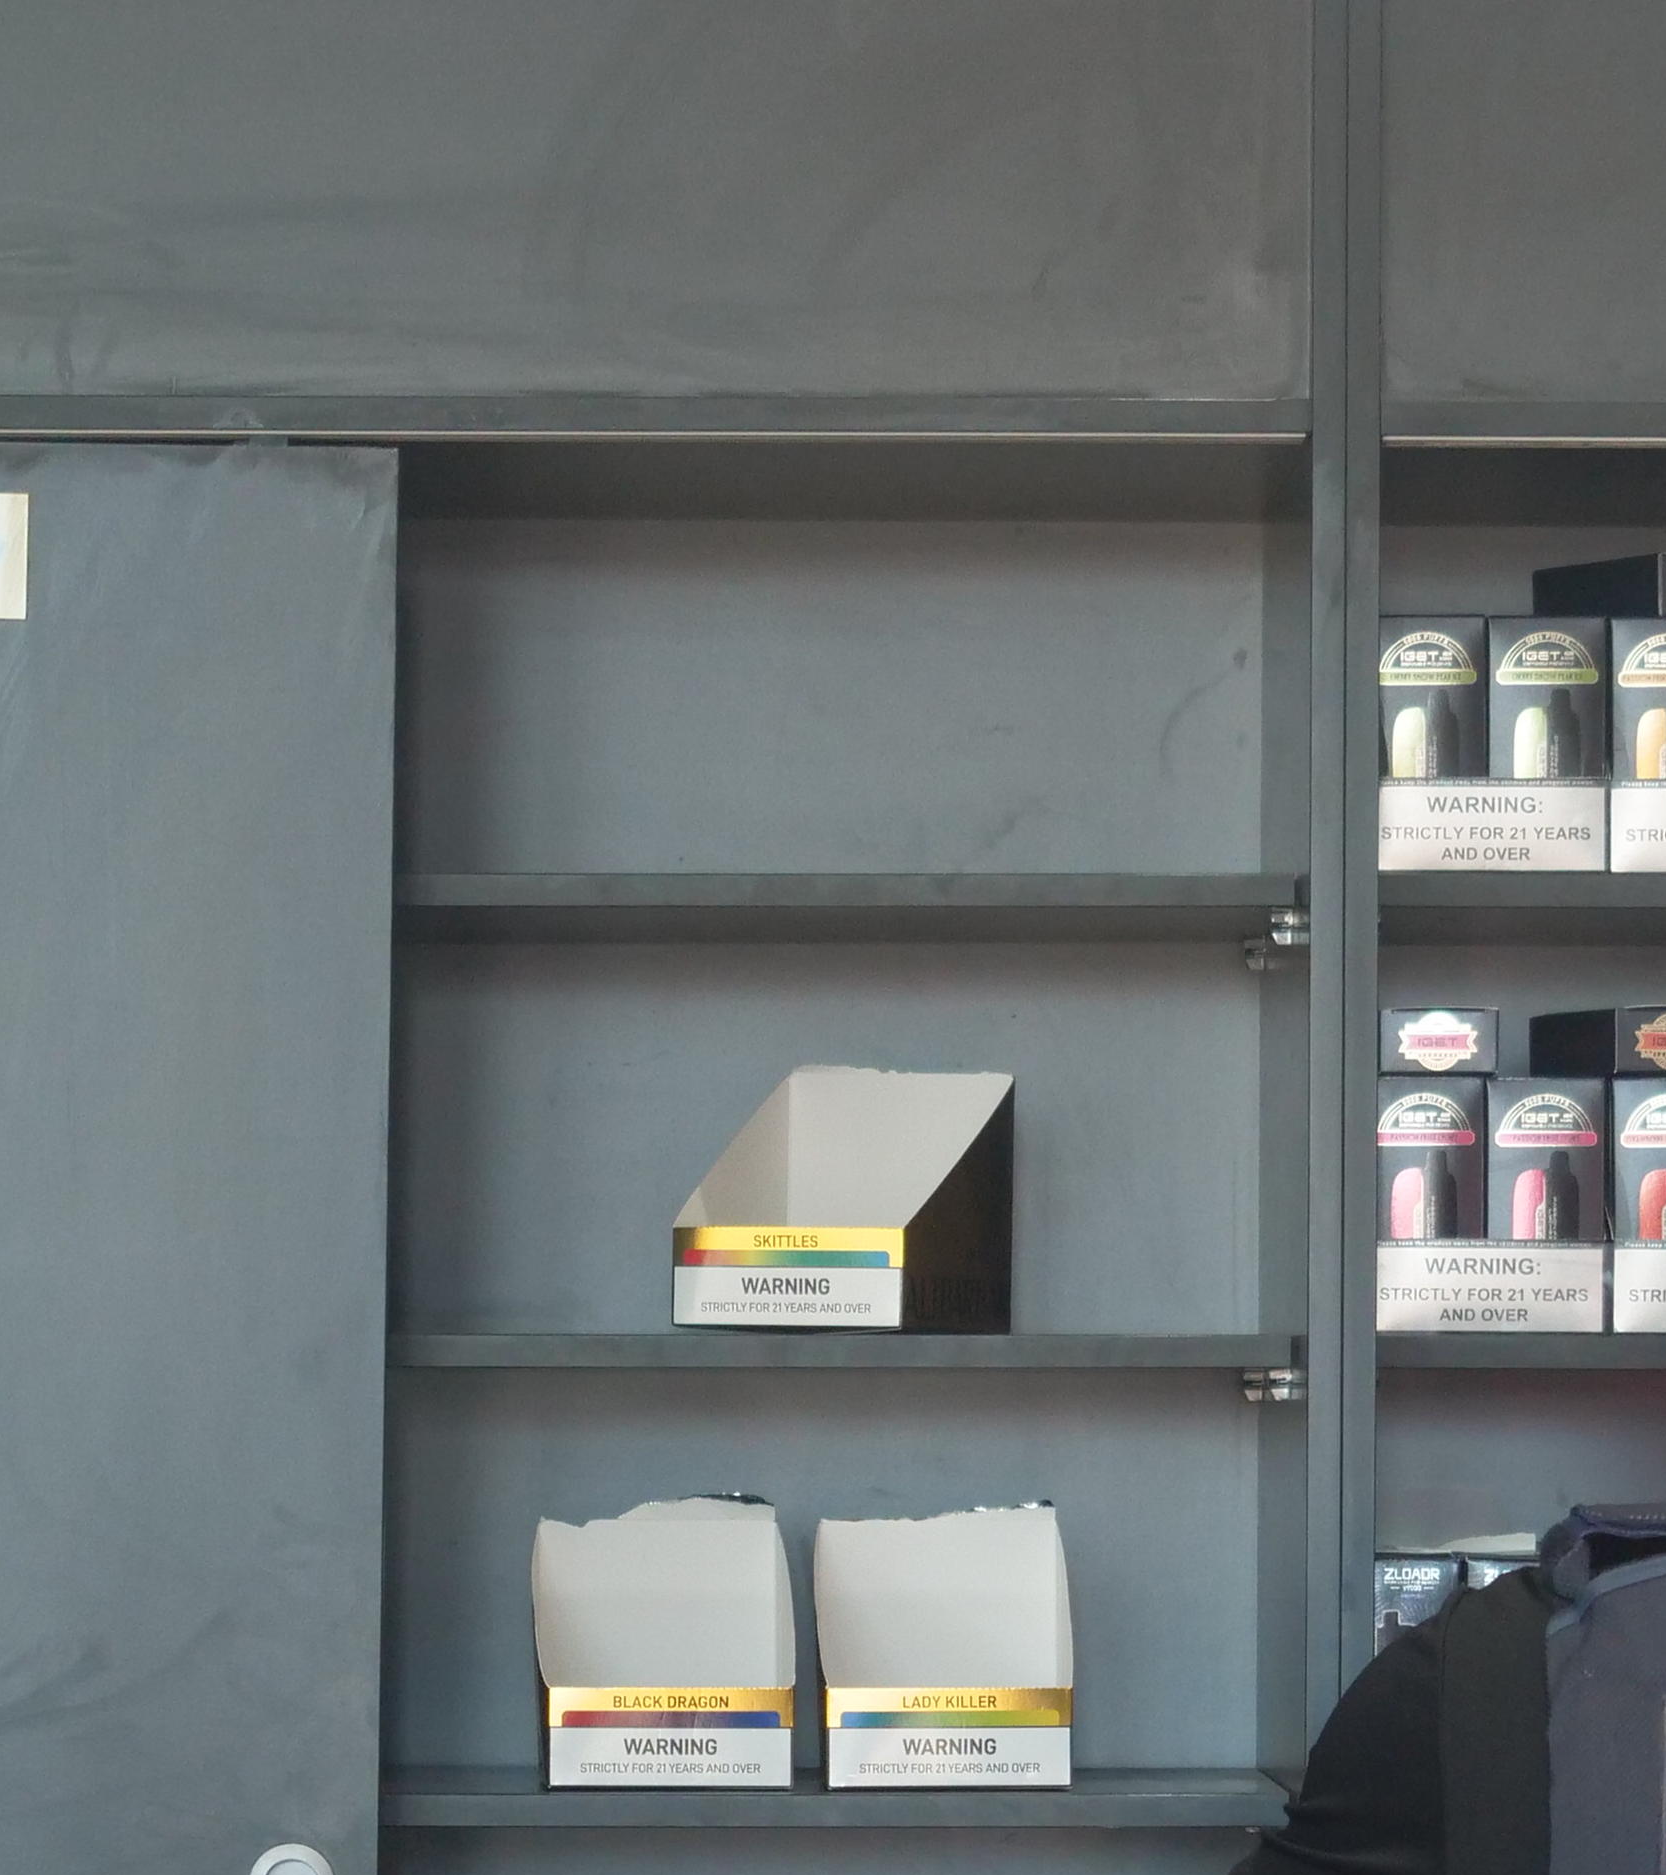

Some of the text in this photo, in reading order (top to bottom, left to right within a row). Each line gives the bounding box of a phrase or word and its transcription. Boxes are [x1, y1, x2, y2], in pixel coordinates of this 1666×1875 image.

[1426, 796, 1544, 814] WARNING:
[1380, 826, 1591, 841] STRICTLY FOR 21 YEARS
[1441, 847, 1531, 861] AND OVER
[753, 1234, 819, 1248] SKITTLES
[1425, 1257, 1542, 1276] WARNING:
[741, 1277, 830, 1295] WARNING
[1379, 1287, 1589, 1303] STRICTLY FOR 21 YEARS
[700, 1301, 871, 1314] STRICTLY FOR 21 YEARS AND OVER
[1439, 1308, 1528, 1323] AND OVER
[613, 1696, 729, 1709] BLACK DRAGON
[902, 1696, 997, 1709] LADY KILLER
[623, 1738, 718, 1756] WARNING
[902, 1738, 997, 1756] WARNING
[580, 1763, 761, 1774] STRICTLY FOR 21 YEARS AND OVER
[859, 1763, 1040, 1774] STRICTLY FOR 21 YEARS AND OVER
